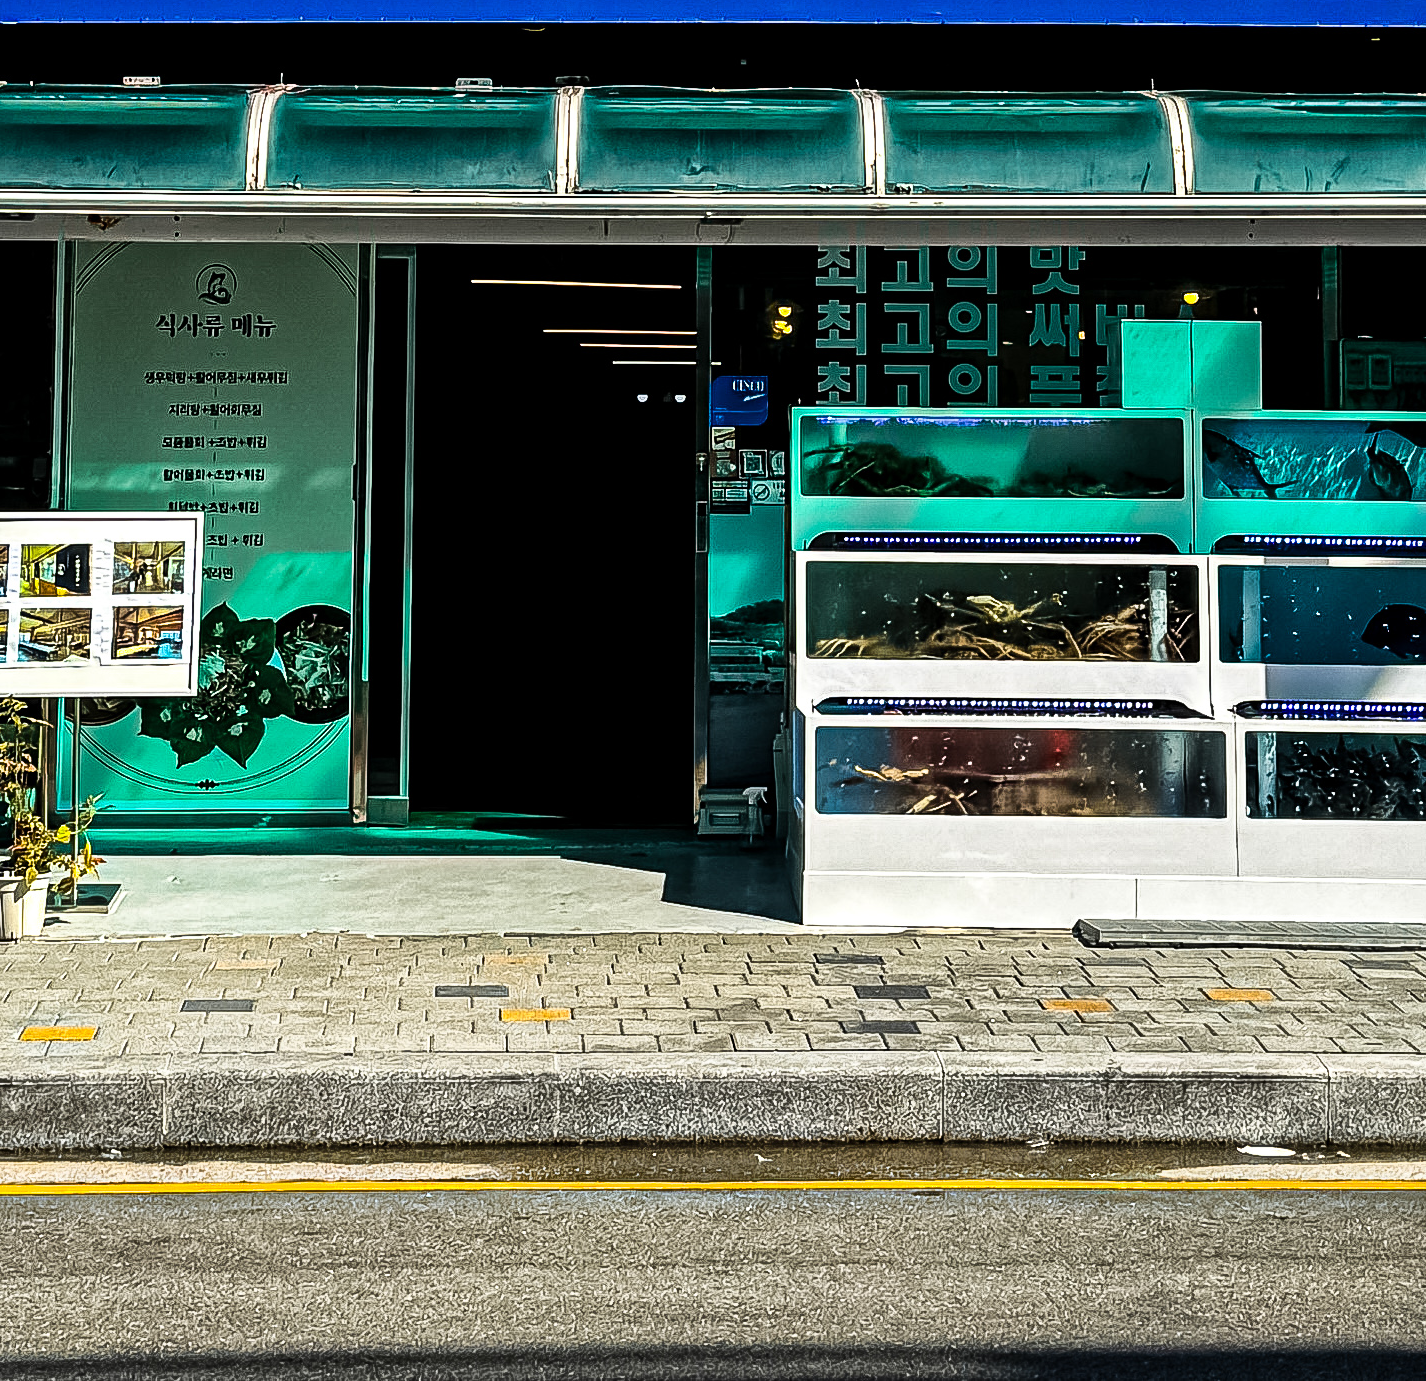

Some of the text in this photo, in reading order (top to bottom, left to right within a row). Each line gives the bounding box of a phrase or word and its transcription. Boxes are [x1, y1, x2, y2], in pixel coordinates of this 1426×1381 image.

[1029, 245, 1086, 295] 맛
[155, 312, 277, 338] 식사류 메뉴
[815, 299, 998, 356] 최고의
